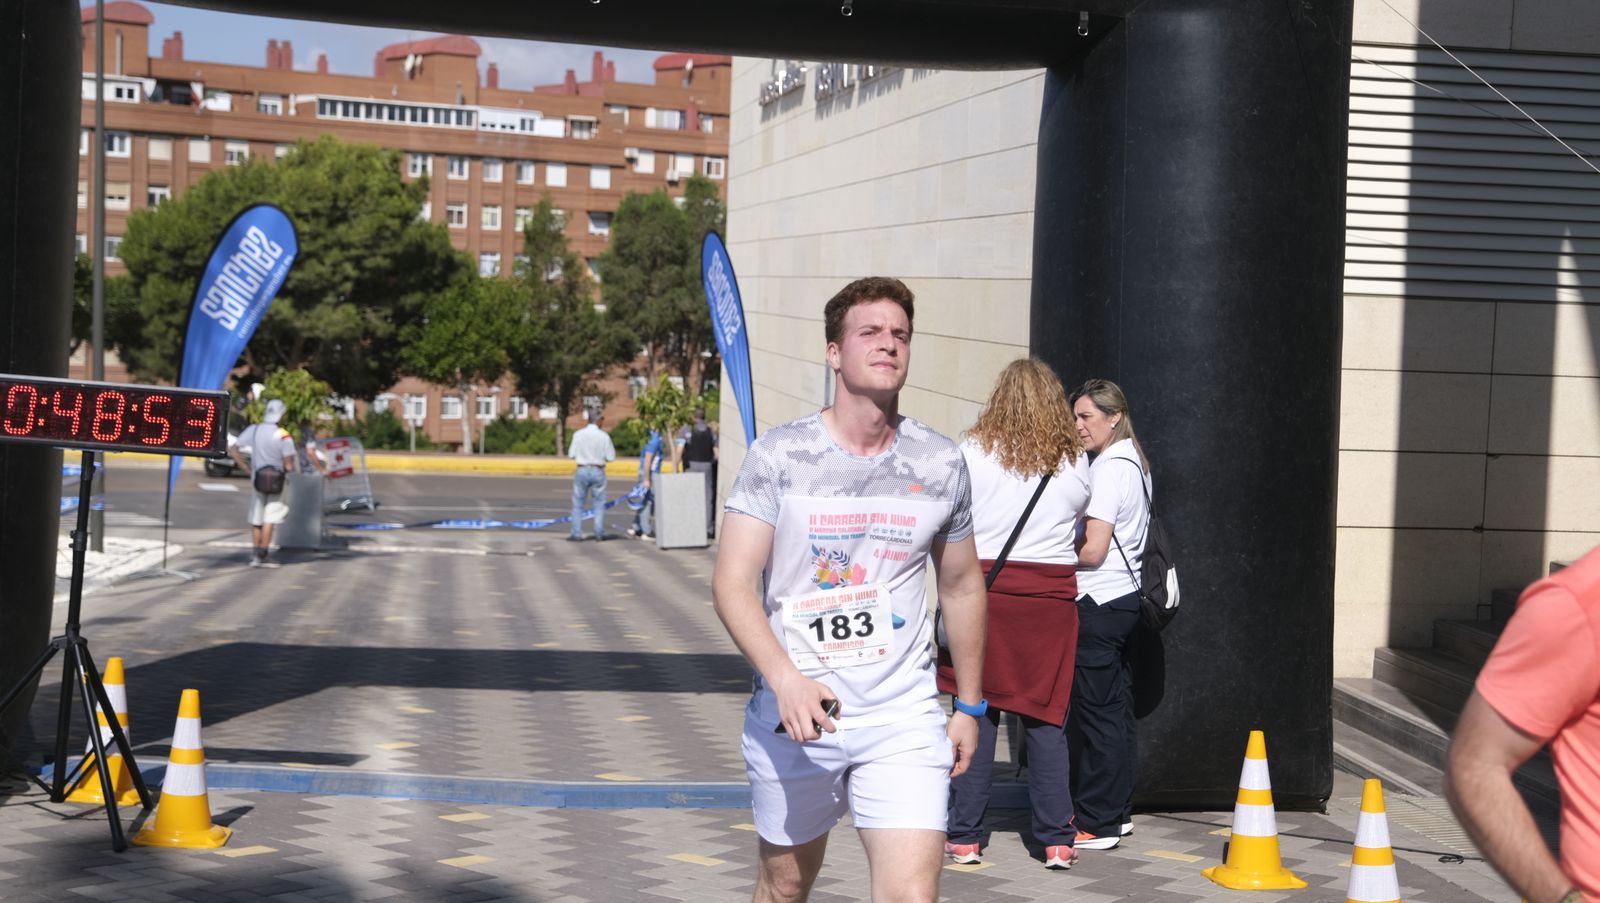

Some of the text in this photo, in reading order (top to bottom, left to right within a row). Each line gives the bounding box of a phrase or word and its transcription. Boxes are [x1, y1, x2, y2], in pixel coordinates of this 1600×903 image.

[3, 384, 216, 448] 0:48:53
[809, 513, 917, 528] II CARRERA SIN HUMO
[873, 548, 909, 561] 4 JUNIO
[800, 596, 837, 610] CARRERA
[839, 593, 853, 603] SIN
[855, 590, 878, 601] HUMO
[808, 611, 875, 642] 183
